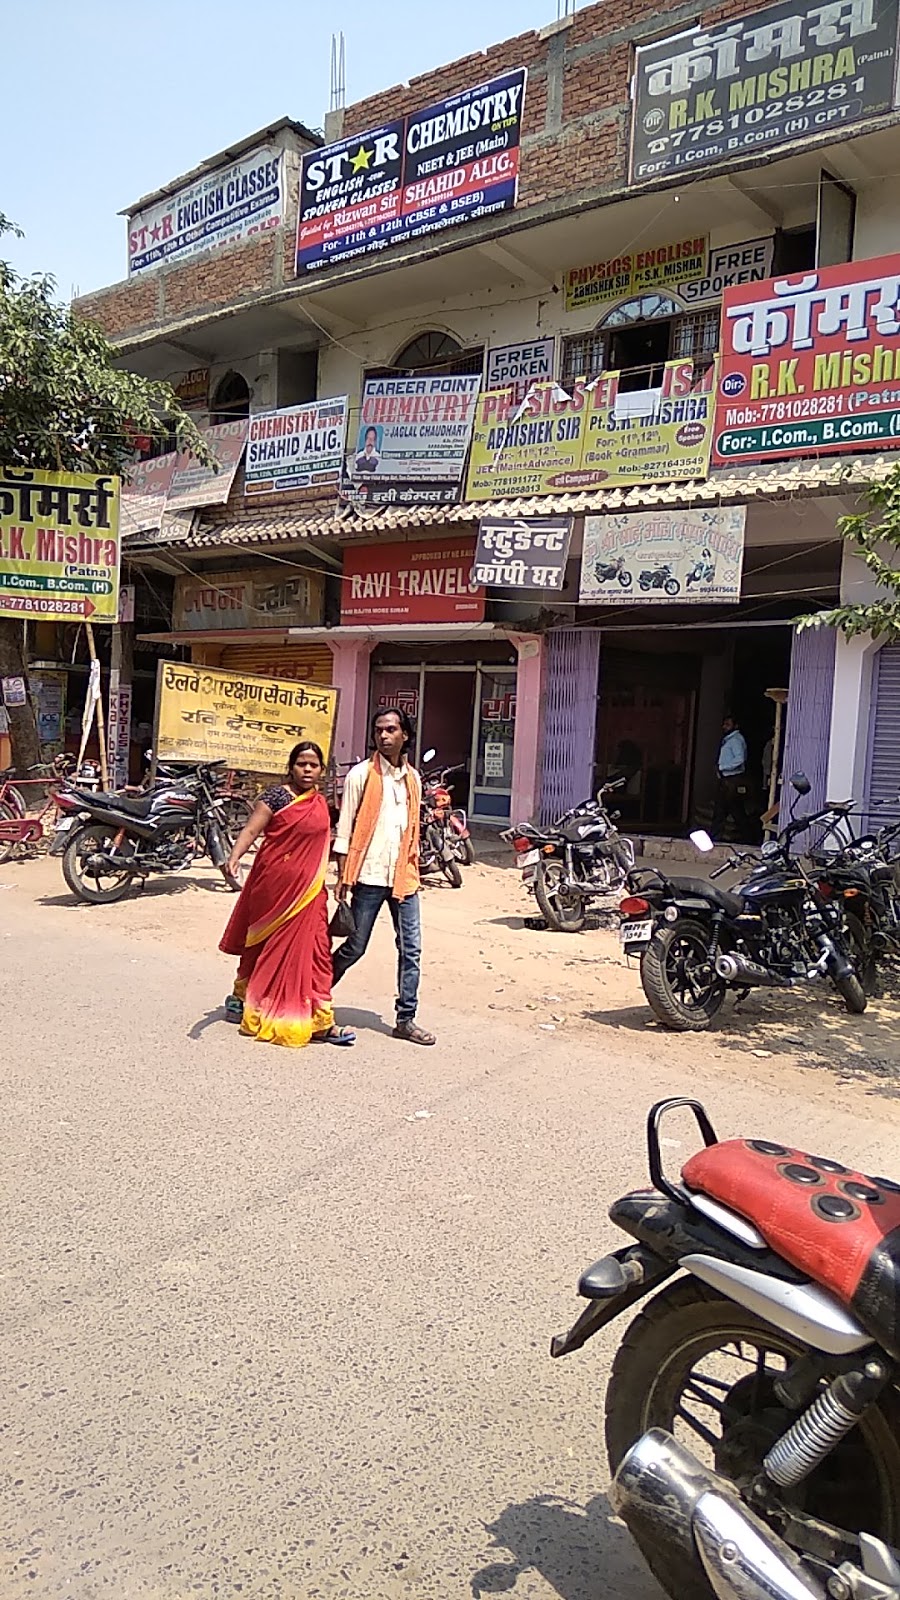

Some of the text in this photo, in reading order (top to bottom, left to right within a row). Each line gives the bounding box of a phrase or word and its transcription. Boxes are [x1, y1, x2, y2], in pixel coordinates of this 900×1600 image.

[644, 0, 877, 95] कॉमस
[669, 88, 722, 130] R.K.
[729, 46, 856, 111] MISHRA
[857, 47, 894, 66] (Patna)
[407, 85, 522, 154] CHEMISTRY
[502, 116, 518, 128] TIPS
[728, 127, 779, 150] B.Com
[785, 117, 809, 135] (H)
[814, 104, 850, 124] CPT
[417, 132, 509, 176] NEET & JEE (Main)
[315, 175, 364, 203] ENGLISH
[405, 152, 515, 205] SHAHID ALIG.
[177, 186, 224, 231] ENGLISH
[226, 158, 279, 206] CLASSES
[302, 195, 347, 222] SPOKEN
[350, 177, 400, 206] CLASSES
[471, 200, 506, 218] सीवान
[205, 205, 250, 231] Competitive
[216, 222, 243, 240] Training
[300, 222, 322, 240] Guided
[333, 203, 377, 228] Rizwan
[380, 194, 399, 209] Sir
[345, 232, 366, 246] 11th
[368, 227, 377, 237] &
[380, 218, 402, 233] 12th
[405, 208, 437, 228] (CBSE
[438, 203, 448, 214] &
[451, 191, 485, 212] BSEB)
[636, 237, 705, 270] ENGLISH
[664, 257, 703, 277] MISHRA
[714, 246, 766, 272] FREE
[574, 273, 630, 299] ABHISHEK SIR
[686, 266, 766, 299] SPOKEN
[726, 274, 900, 356] कॉम
[490, 358, 549, 382] SPOKEN
[495, 345, 546, 367] FREE
[181, 369, 208, 387] OLOGY
[367, 380, 427, 395] CAREER
[430, 378, 478, 394] POINT
[750, 357, 805, 400] R.K.
[362, 393, 474, 424] CHEMISTRY
[848, 391, 900, 412] (Patn
[202, 421, 245, 440] OLOGY
[250, 409, 318, 442] CHEMISTRY
[328, 415, 343, 427] TIPS
[390, 425, 417, 439] JAGLAL
[419, 424, 468, 438] CHAUDHARY
[486, 420, 554, 451] ABHISHEK
[556, 416, 581, 441] SIR
[590, 416, 606, 431] Pt.
[249, 436, 300, 463] SHAHID
[303, 429, 341, 454] ALIG.
[722, 435, 757, 452] For:-
[823, 420, 884, 440] B.Com.
[128, 455, 175, 478] OLOGY
[36, 528, 117, 567] Mishra
[481, 520, 568, 559] स्टुडेन्ट
[411, 551, 442, 561] APPROVED
[442, 551, 451, 559] BY
[47, 579, 89, 591] B.Com.
[91, 581, 109, 594] (H)
[64, 565, 112, 580] (Patna)
[351, 572, 391, 599] RAVI
[475, 558, 562, 587] कॉपी घर
[202, 676, 264, 703] आरक्षण
[264, 683, 295, 707] सेवा
[294, 687, 331, 714] केन्द्र
[118, 693, 130, 747] PHYSICS
[181, 709, 218, 726] रवि
